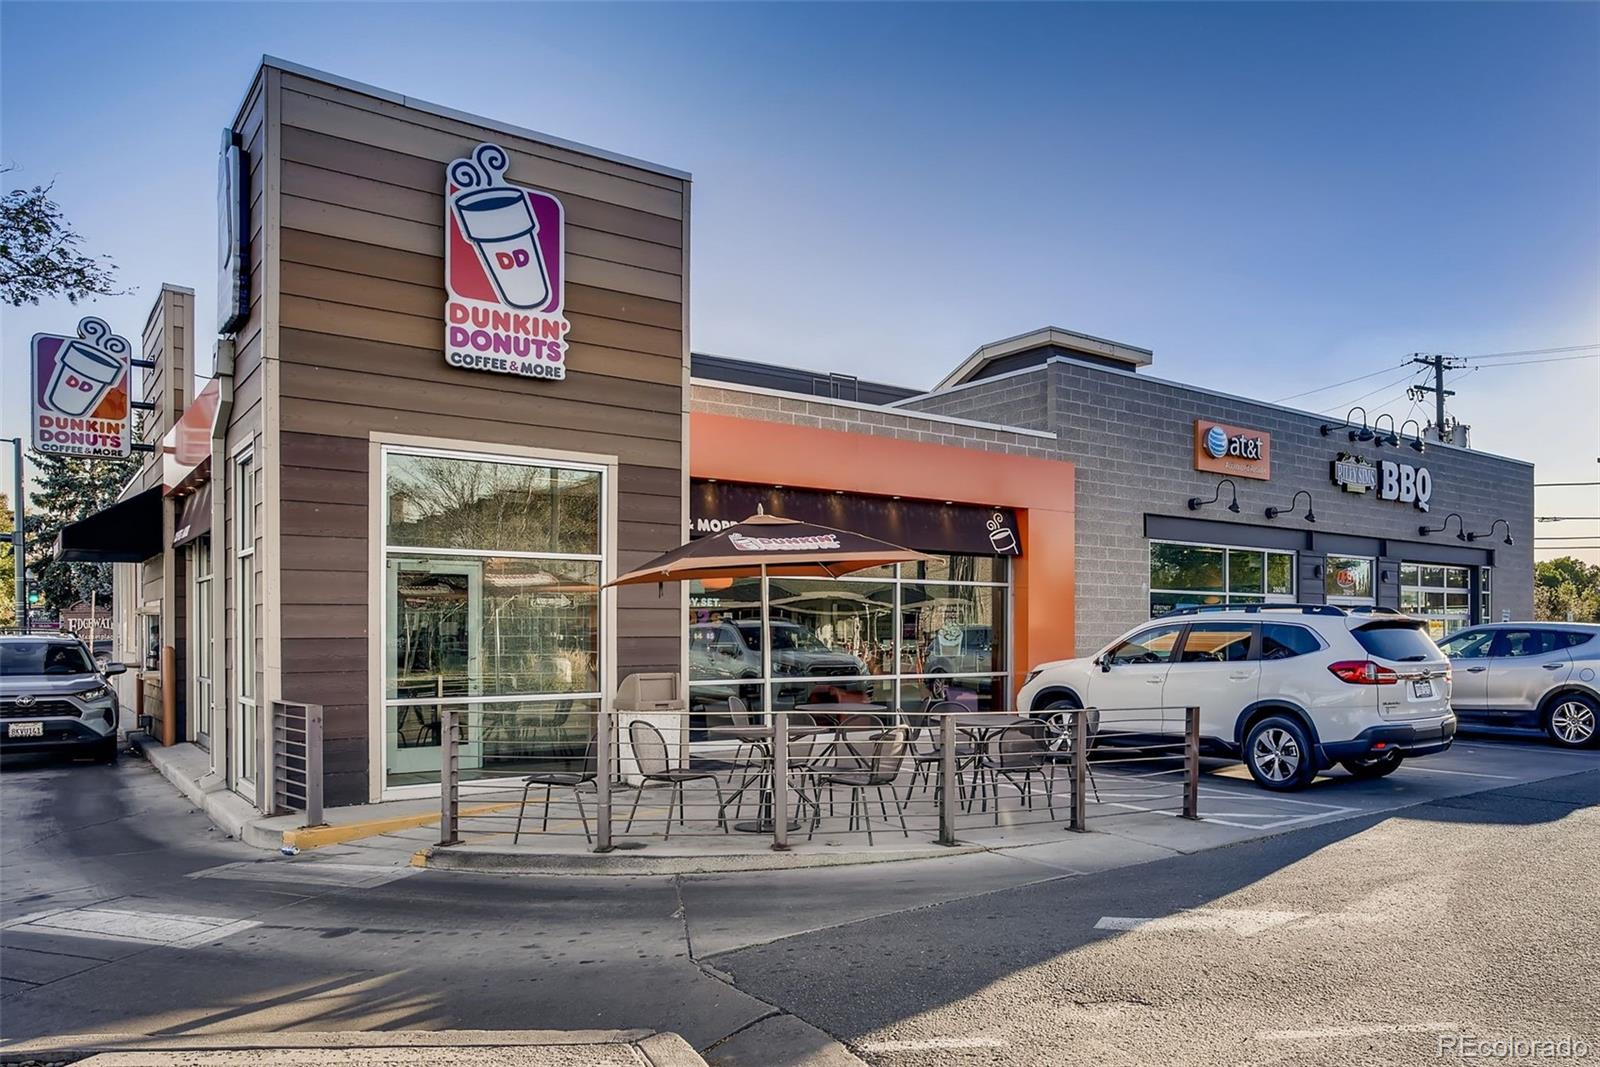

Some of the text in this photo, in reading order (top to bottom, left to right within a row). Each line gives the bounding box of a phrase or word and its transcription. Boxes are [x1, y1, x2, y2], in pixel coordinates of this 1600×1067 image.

[496, 249, 529, 270] DD
[450, 302, 568, 339] DUNKIN'
[450, 326, 562, 362] DONUTS
[450, 352, 561, 378] COFFEE & MORE
[65, 375, 94, 393] DD
[39, 415, 126, 434] DUNKIN'
[39, 429, 122, 448] DONUTS
[41, 443, 83, 453] COFFEE
[92, 448, 123, 457] MORE
[1230, 435, 1263, 460] at&t
[1382, 460, 1432, 512] BBQ
